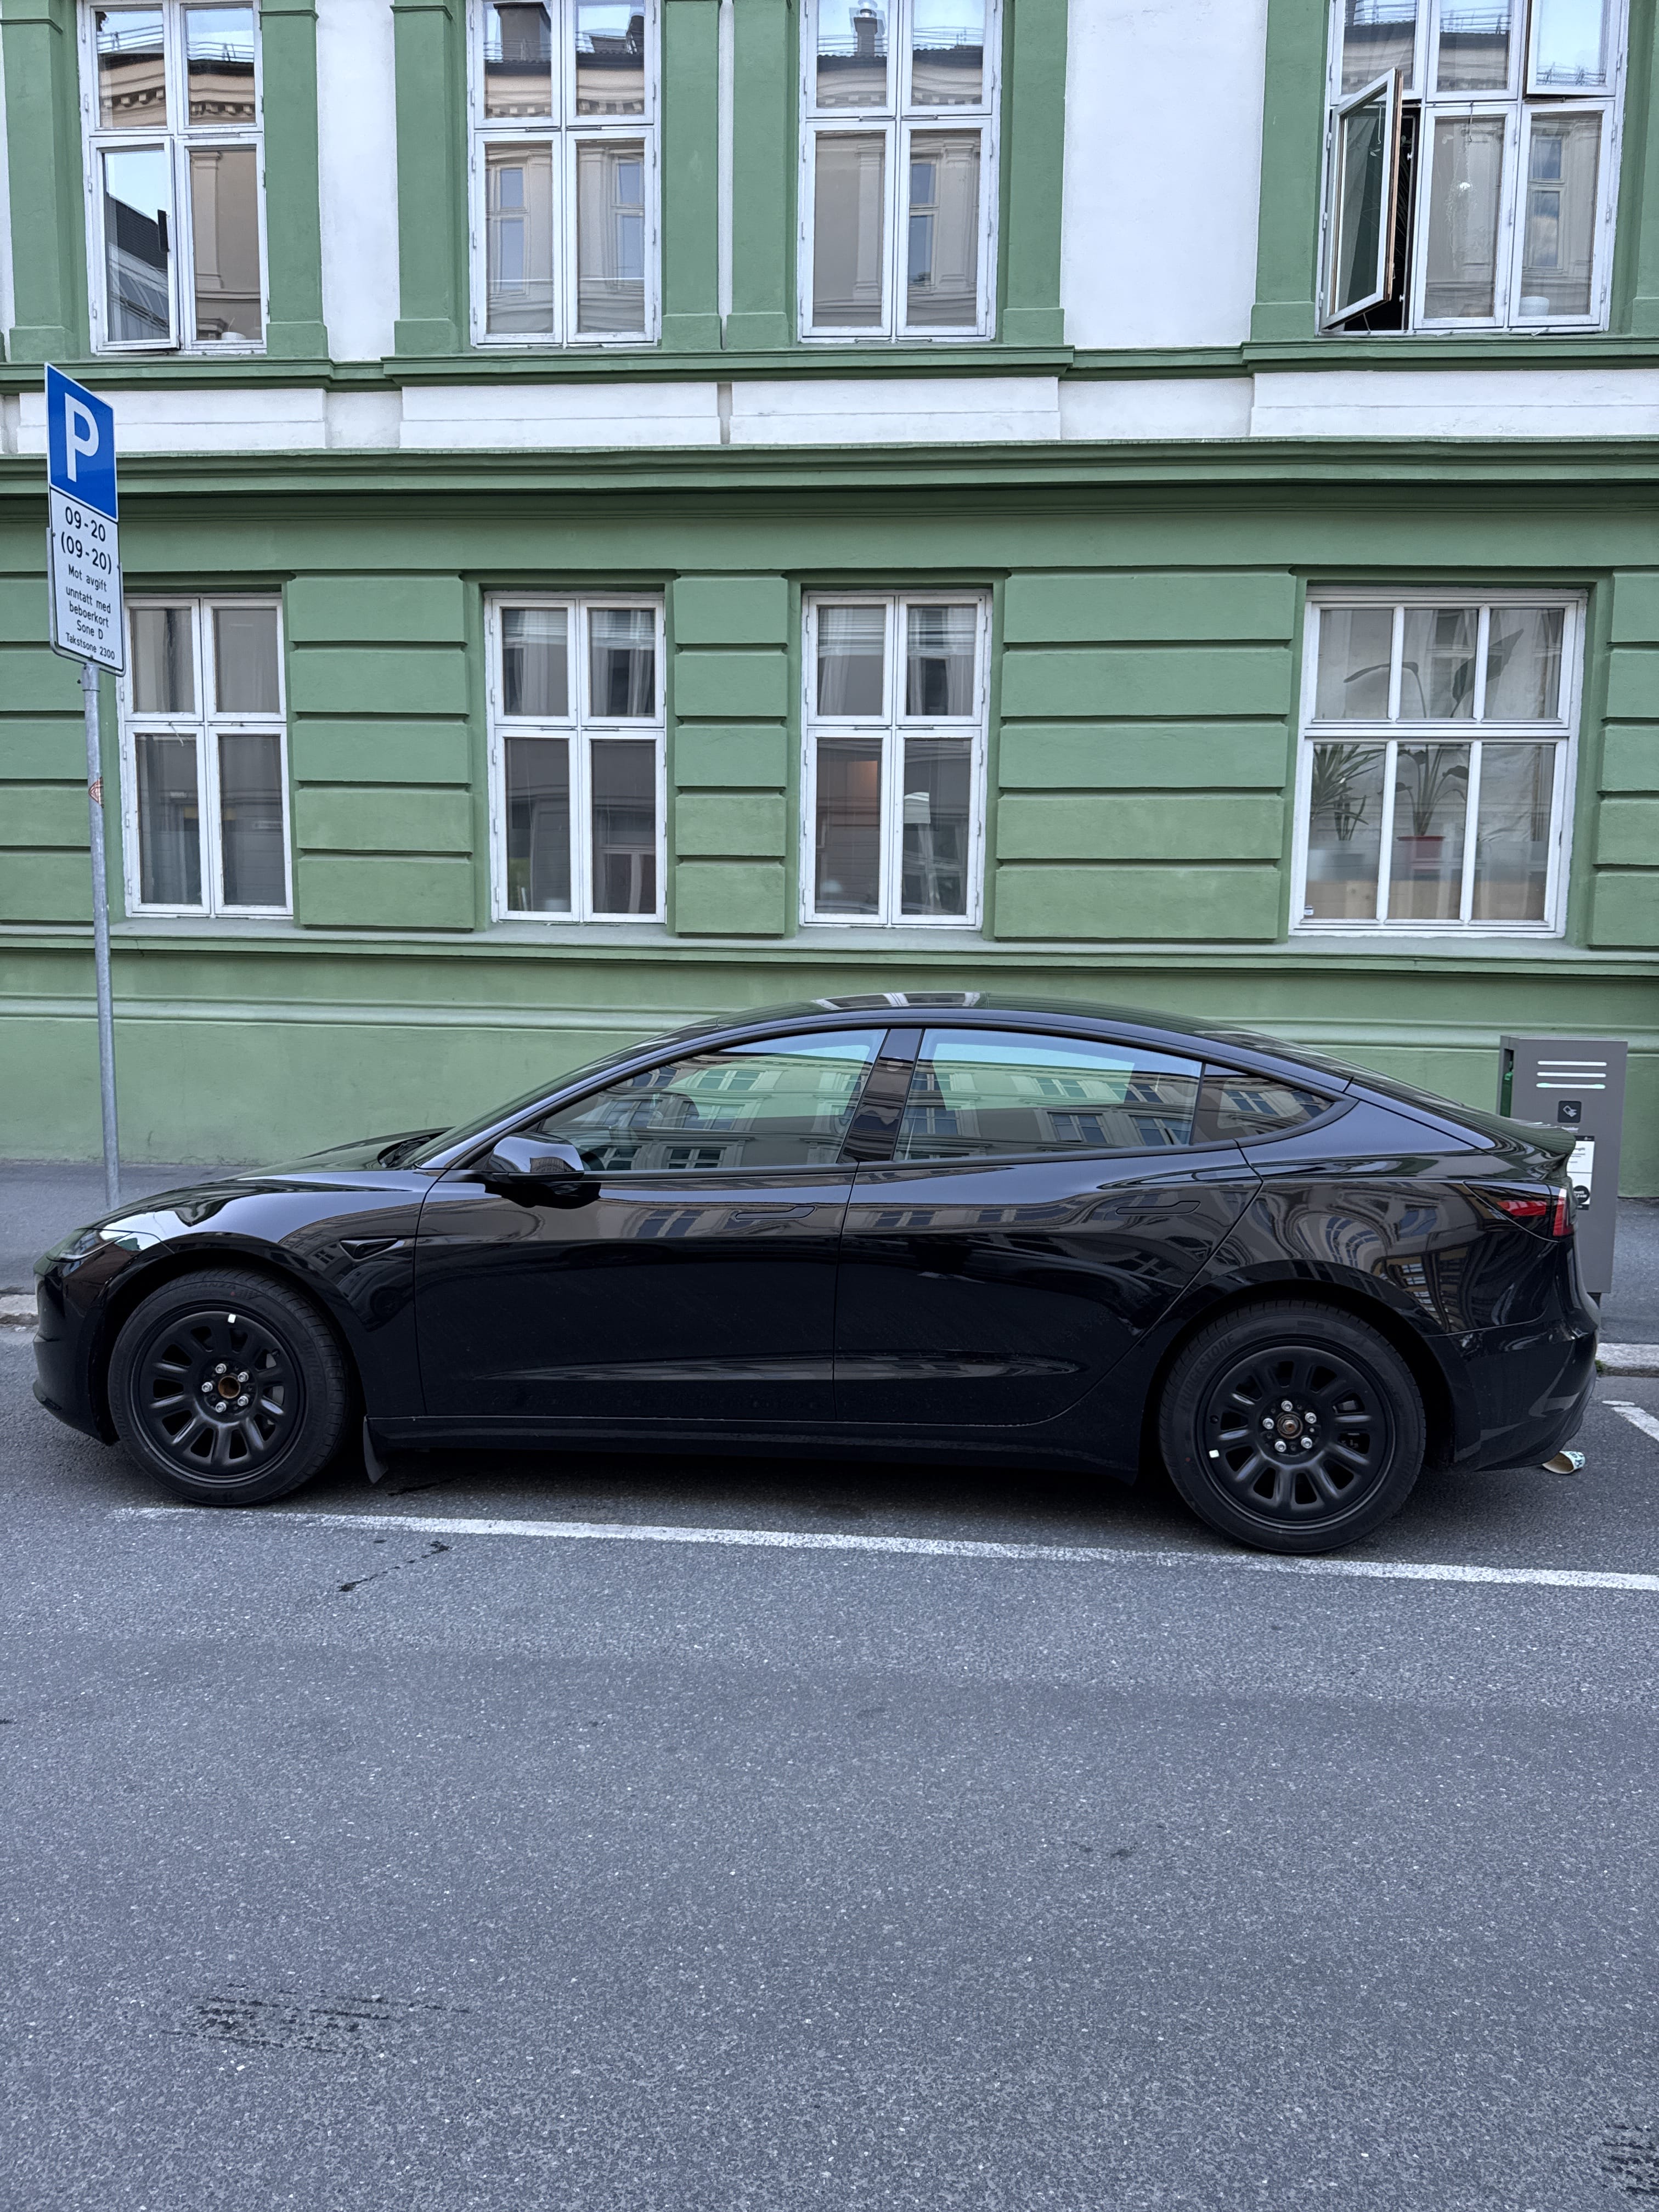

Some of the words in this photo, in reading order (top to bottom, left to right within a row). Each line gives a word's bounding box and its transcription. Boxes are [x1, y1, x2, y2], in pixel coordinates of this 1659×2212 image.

[65, 392, 99, 482] P
[65, 506, 105, 542] 09-20
[61, 532, 111, 574] (09-20)
[69, 564, 82, 581] Mot
[86, 575, 107, 592] avgift
[66, 586, 92, 606] unntatt
[96, 600, 111, 614] med
[69, 601, 109, 628] beboerkort
[77, 619, 94, 636] Sone
[98, 629, 103, 640] D
[66, 632, 97, 653] Takstsone
[99, 646, 115, 660] 2300
